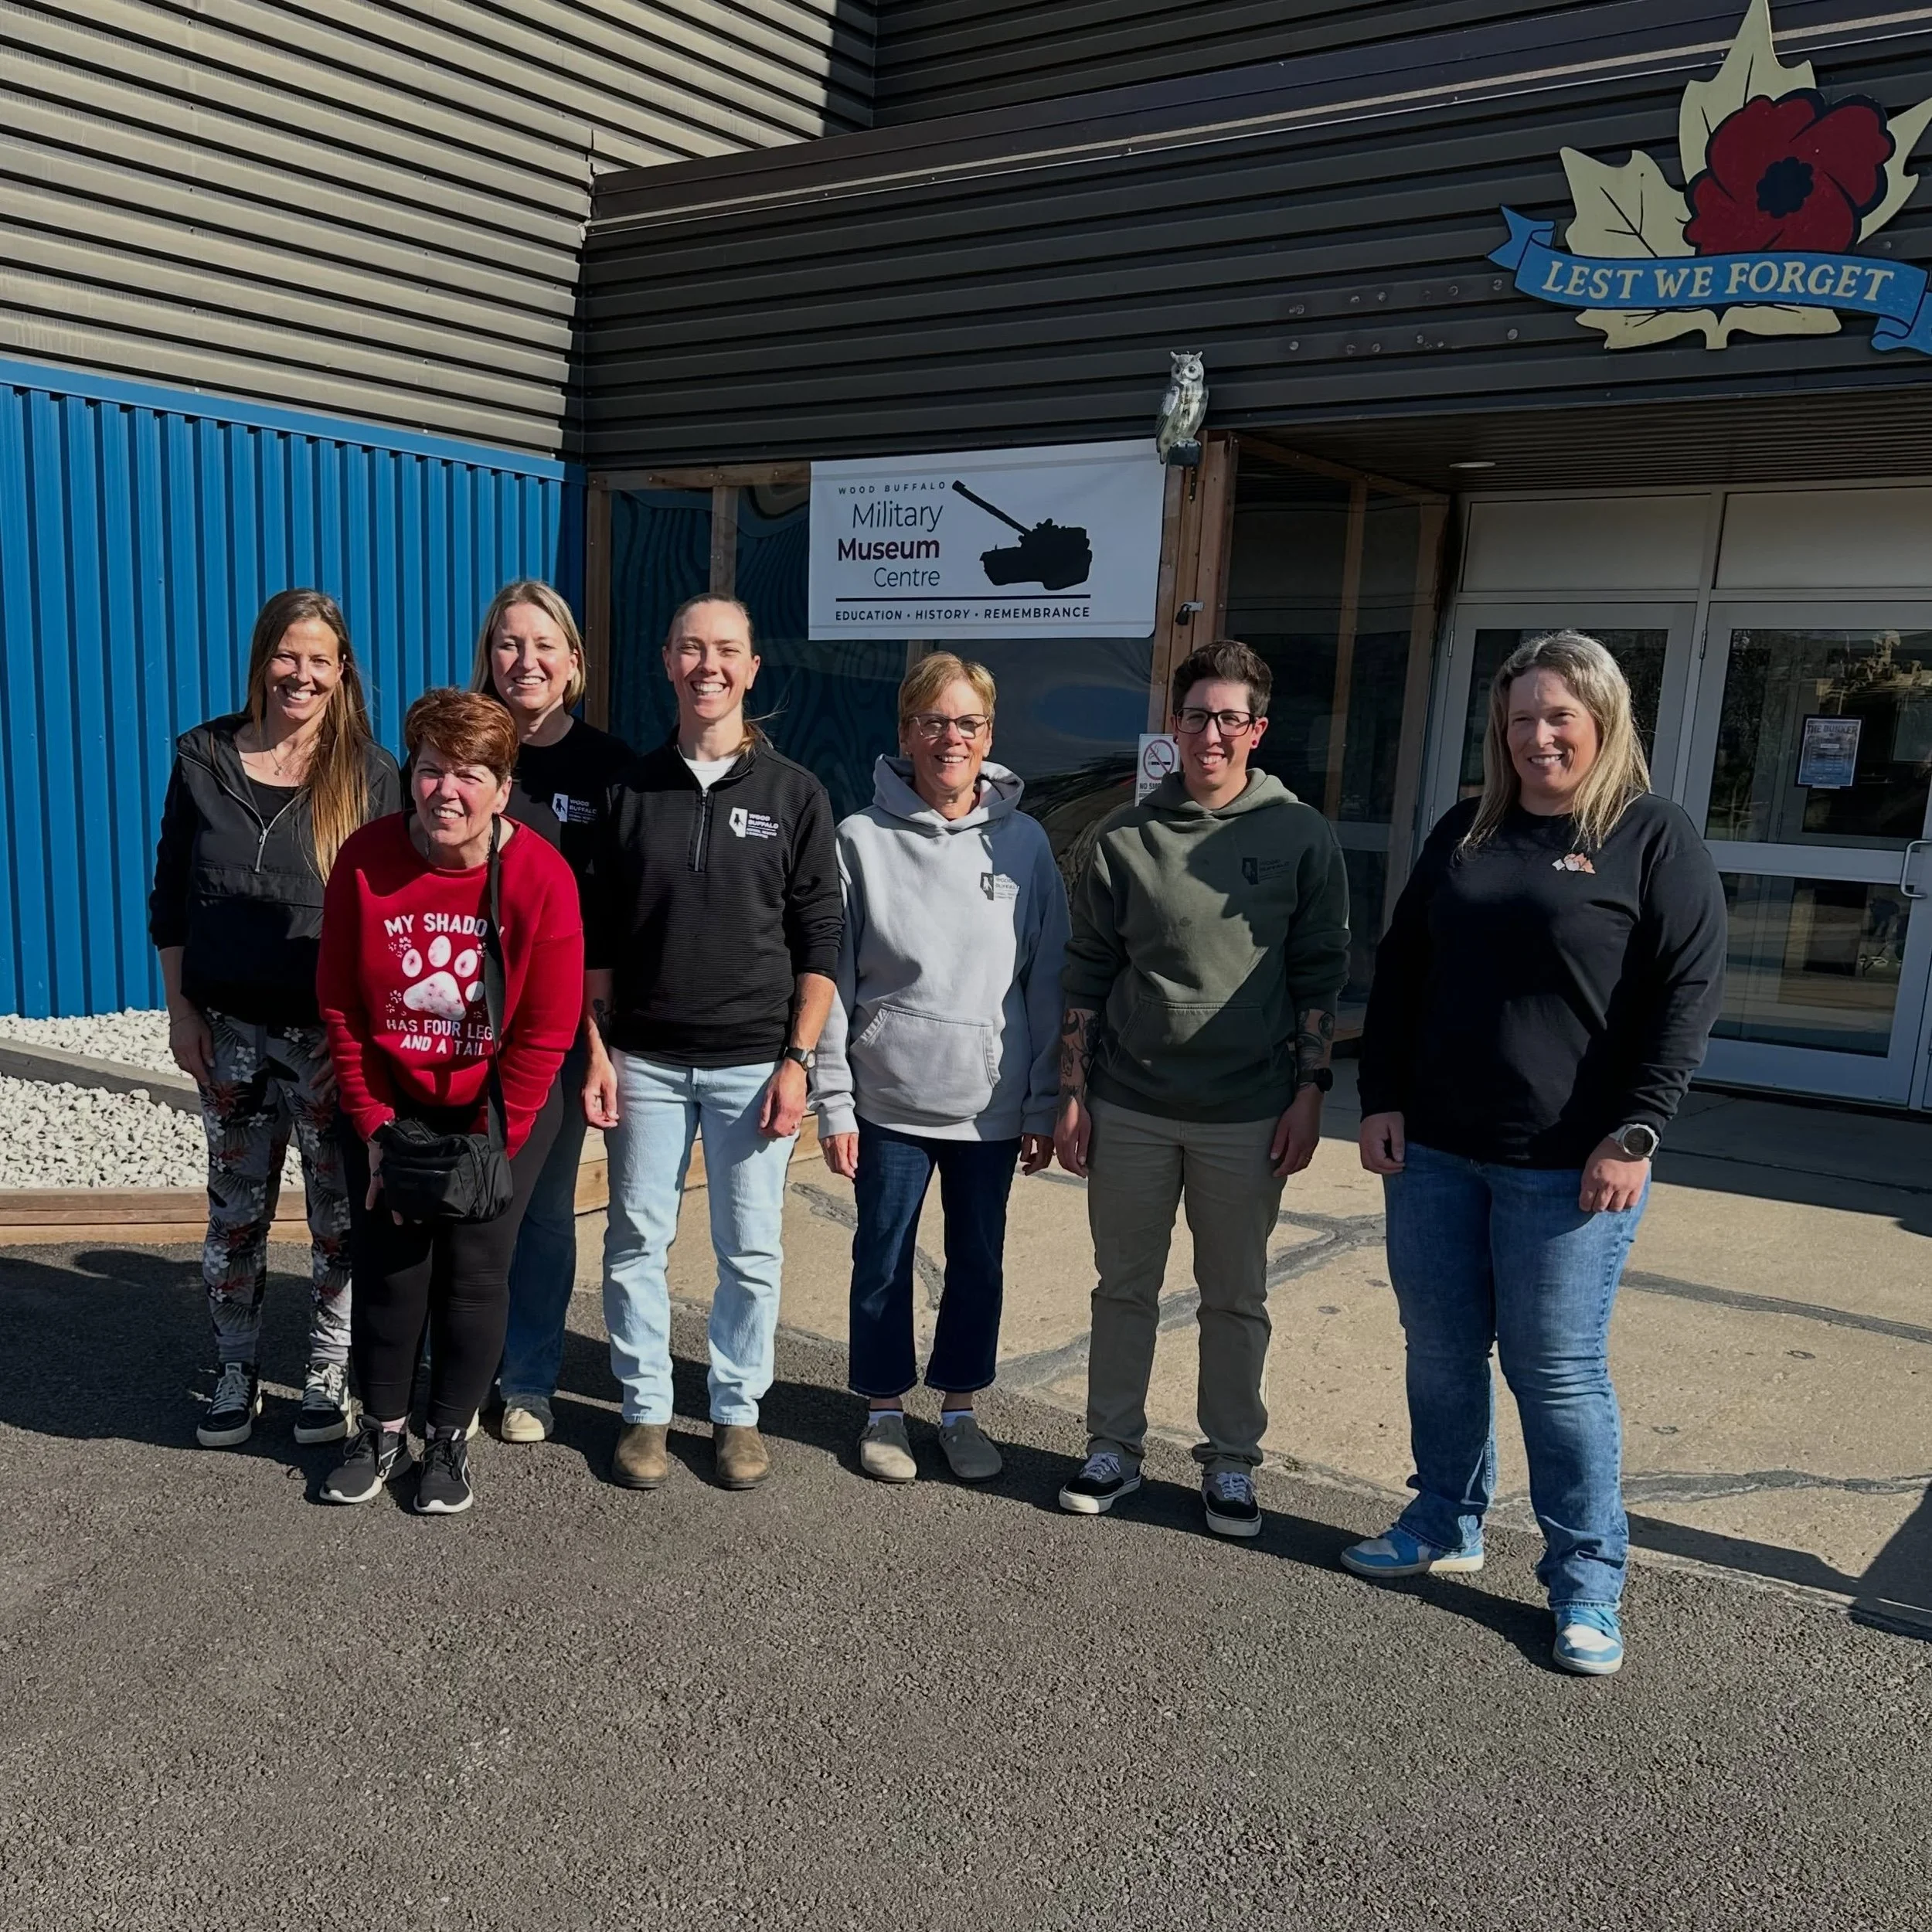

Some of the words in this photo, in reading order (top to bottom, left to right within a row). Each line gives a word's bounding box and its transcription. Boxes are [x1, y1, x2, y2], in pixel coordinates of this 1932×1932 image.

[1542, 260, 1644, 299] LEST
[1654, 267, 1714, 298] WE
[1725, 261, 1894, 301] FORGET
[838, 485, 876, 495] WOOD
[884, 481, 946, 493] BUFFALO
[852, 501, 944, 532] Military
[838, 538, 940, 562] Museum
[873, 566, 940, 588] Centre
[835, 609, 903, 621] EDUCATION
[916, 608, 971, 620] HISTORY
[984, 607, 1090, 619] REMEMBRANCE
[747, 819, 779, 829] BUFFALO
[384, 914, 415, 937] MY
[423, 913, 505, 937] SHADO
[386, 1019, 418, 1032] HAS
[423, 1019, 461, 1037] FOUR
[467, 1022, 495, 1040] LEG
[400, 1035, 432, 1053] AND
[436, 1039, 447, 1055] A
[454, 1039, 486, 1056] TAIL
